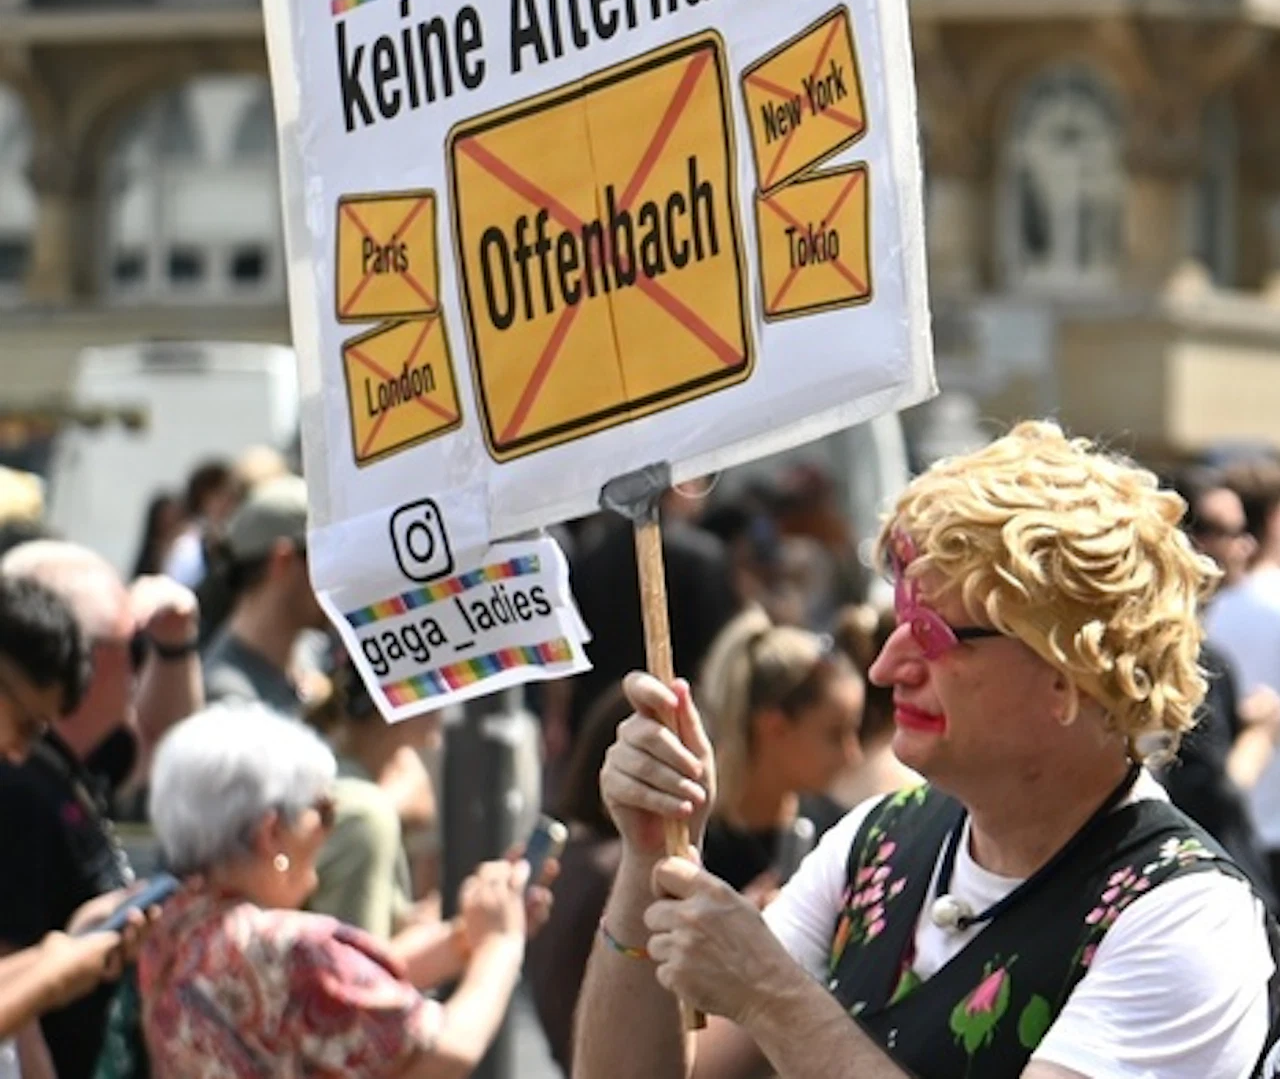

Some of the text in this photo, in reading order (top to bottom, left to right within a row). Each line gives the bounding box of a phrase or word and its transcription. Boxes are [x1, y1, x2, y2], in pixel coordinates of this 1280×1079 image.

[336, 0, 486, 132] keine
[761, 58, 847, 145] New York
[362, 233, 409, 275] Paris
[478, 156, 720, 331] Offenbach
[784, 221, 840, 269] Tokio
[365, 362, 436, 418] London
[361, 582, 552, 676] gaga_ladies
